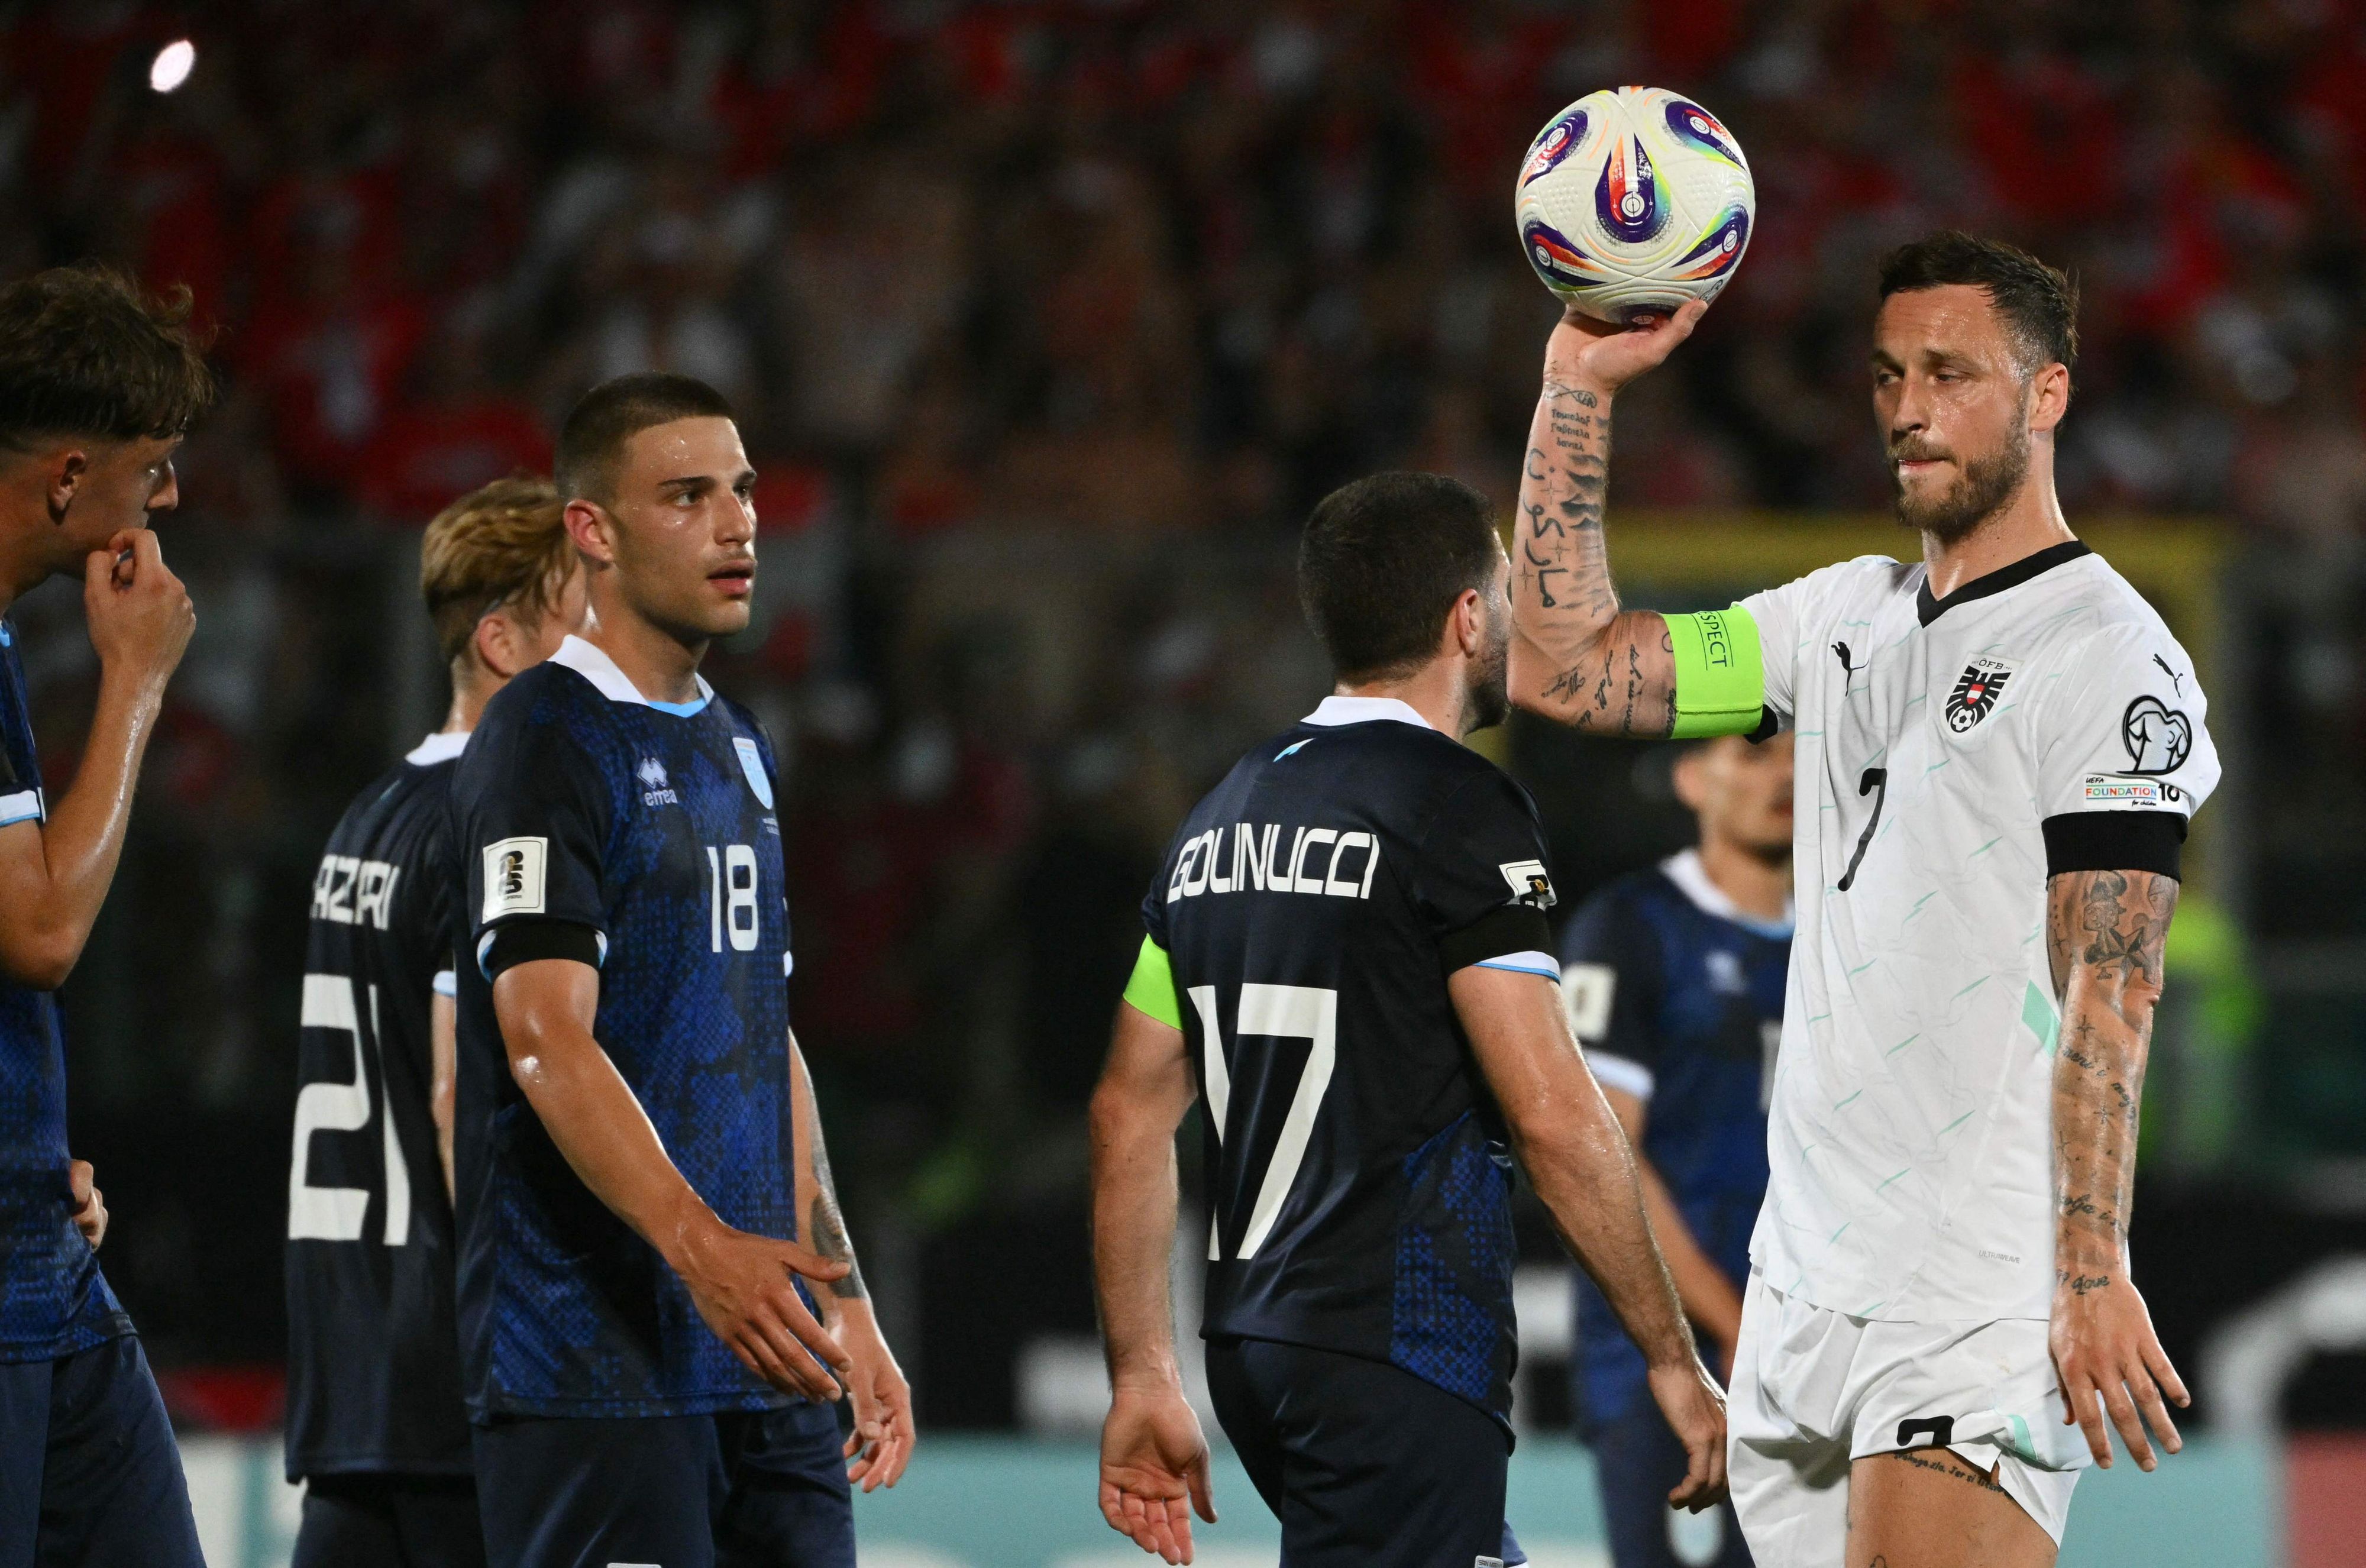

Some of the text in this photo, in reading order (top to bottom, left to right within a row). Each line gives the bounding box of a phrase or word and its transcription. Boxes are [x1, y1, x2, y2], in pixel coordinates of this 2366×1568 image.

[1698, 612, 1727, 667] SPECT
[1979, 658, 2004, 670] ÖFB
[2086, 787, 2157, 796] FOUNDATION
[2158, 783, 2180, 802] 10
[1166, 823, 1380, 904] GOLINUCCI
[1838, 768, 1887, 891] 7
[708, 845, 759, 953] 18
[287, 974, 411, 1246] 21
[1187, 982, 1337, 1262] 17
[1979, 1250, 2021, 1264] ULTRAWEAVE
